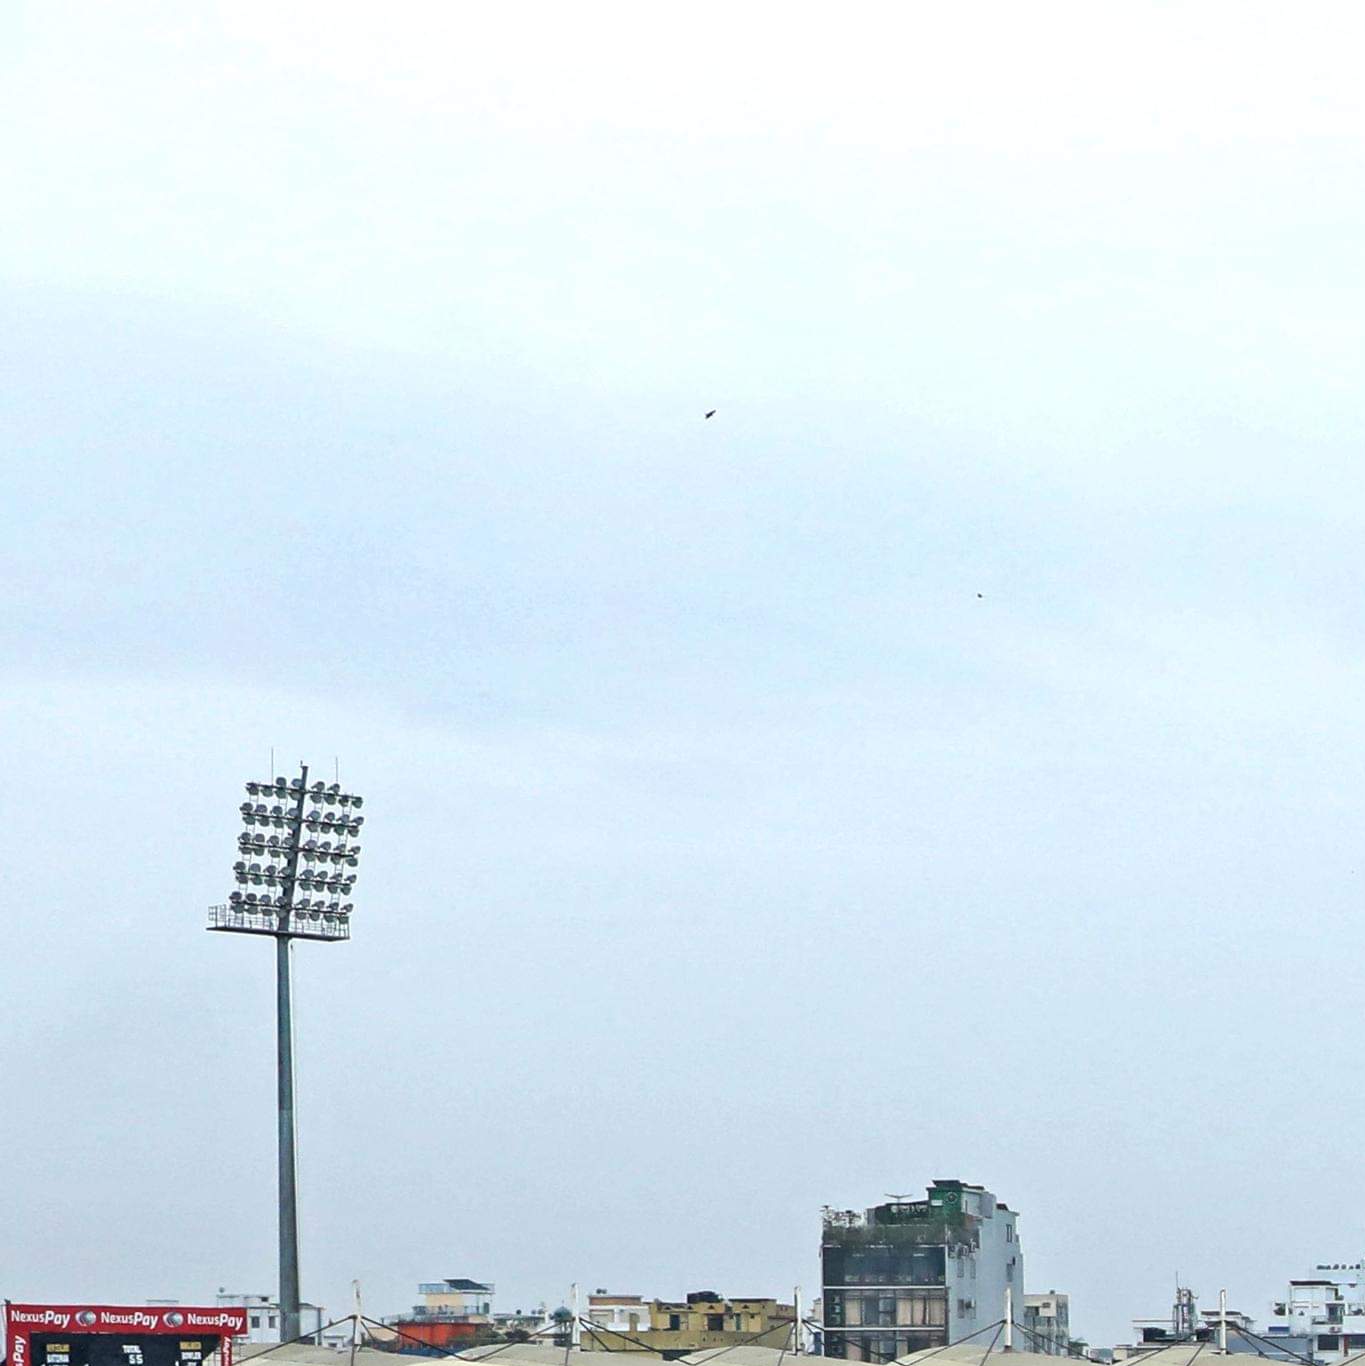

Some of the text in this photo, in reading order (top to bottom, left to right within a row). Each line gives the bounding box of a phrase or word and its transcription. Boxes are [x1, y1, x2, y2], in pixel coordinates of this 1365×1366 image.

[11, 1310, 243, 1330] NexusPay NexusPay NexusPay
[129, 1355, 144, 1364] 55
